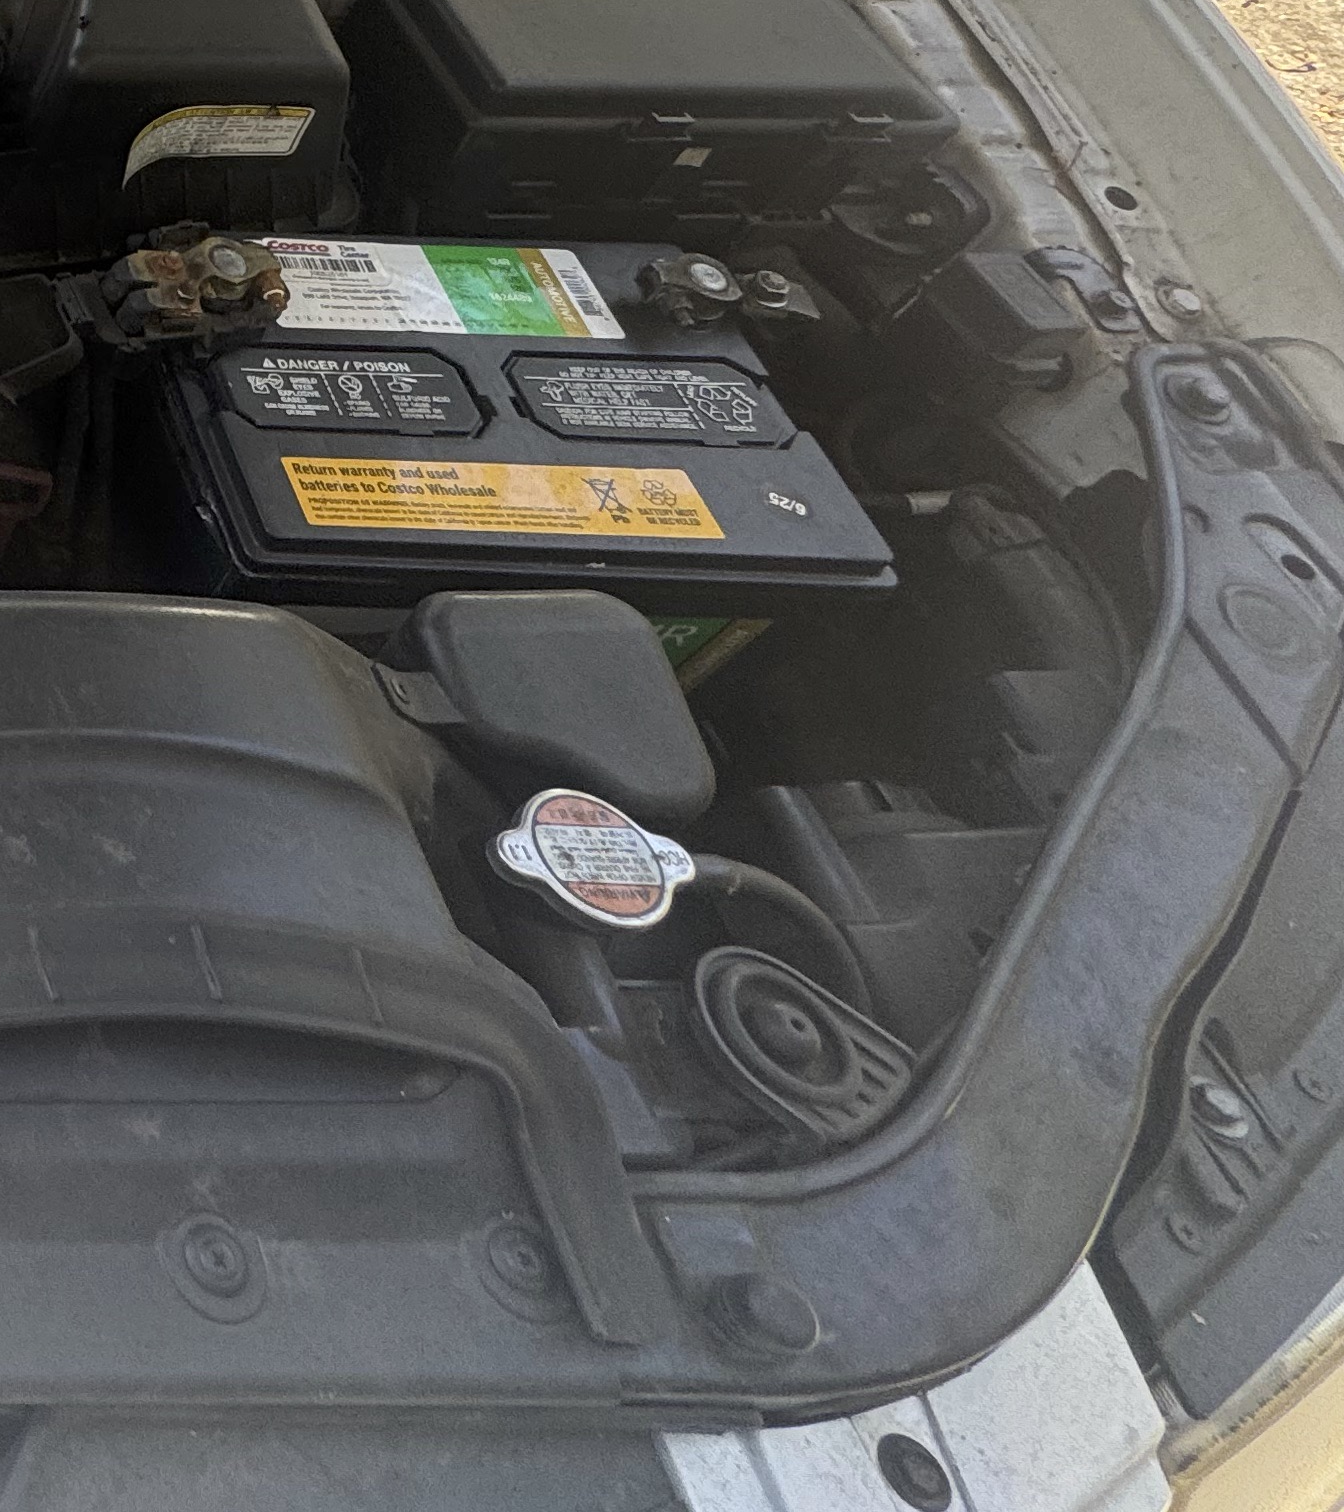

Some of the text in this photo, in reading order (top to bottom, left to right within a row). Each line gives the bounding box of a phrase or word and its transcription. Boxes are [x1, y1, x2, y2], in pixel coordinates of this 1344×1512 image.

[530, 261, 578, 324] AUTOMOTIVE
[276, 358, 339, 371] DANGER
[353, 361, 411, 373] POISON
[291, 463, 460, 480] Return warranty and used
[298, 479, 497, 497] batteries to Costco Wholesale
[768, 491, 808, 516] 6/25
[611, 514, 631, 524] Pb
[507, 843, 533, 862] 1.1
